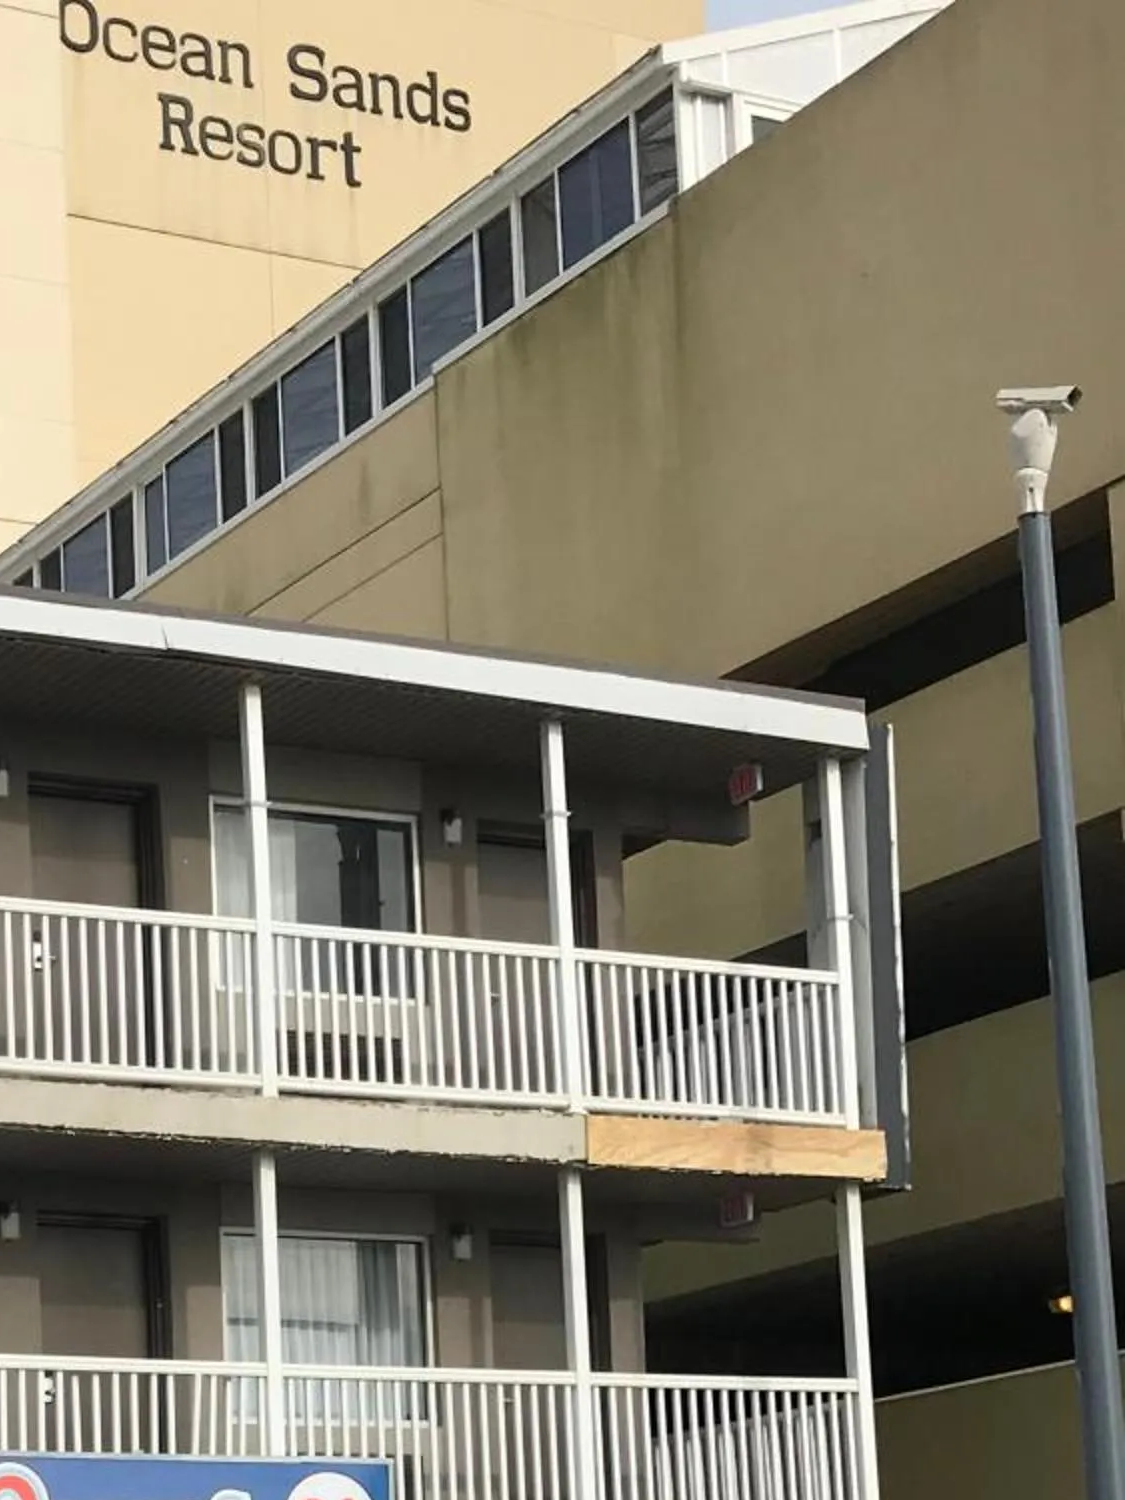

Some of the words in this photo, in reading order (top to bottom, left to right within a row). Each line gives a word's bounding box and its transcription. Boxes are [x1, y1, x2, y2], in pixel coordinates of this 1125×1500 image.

[58, 0, 255, 89] Ocean
[286, 43, 472, 133] Sands
[156, 91, 363, 188] Resort
